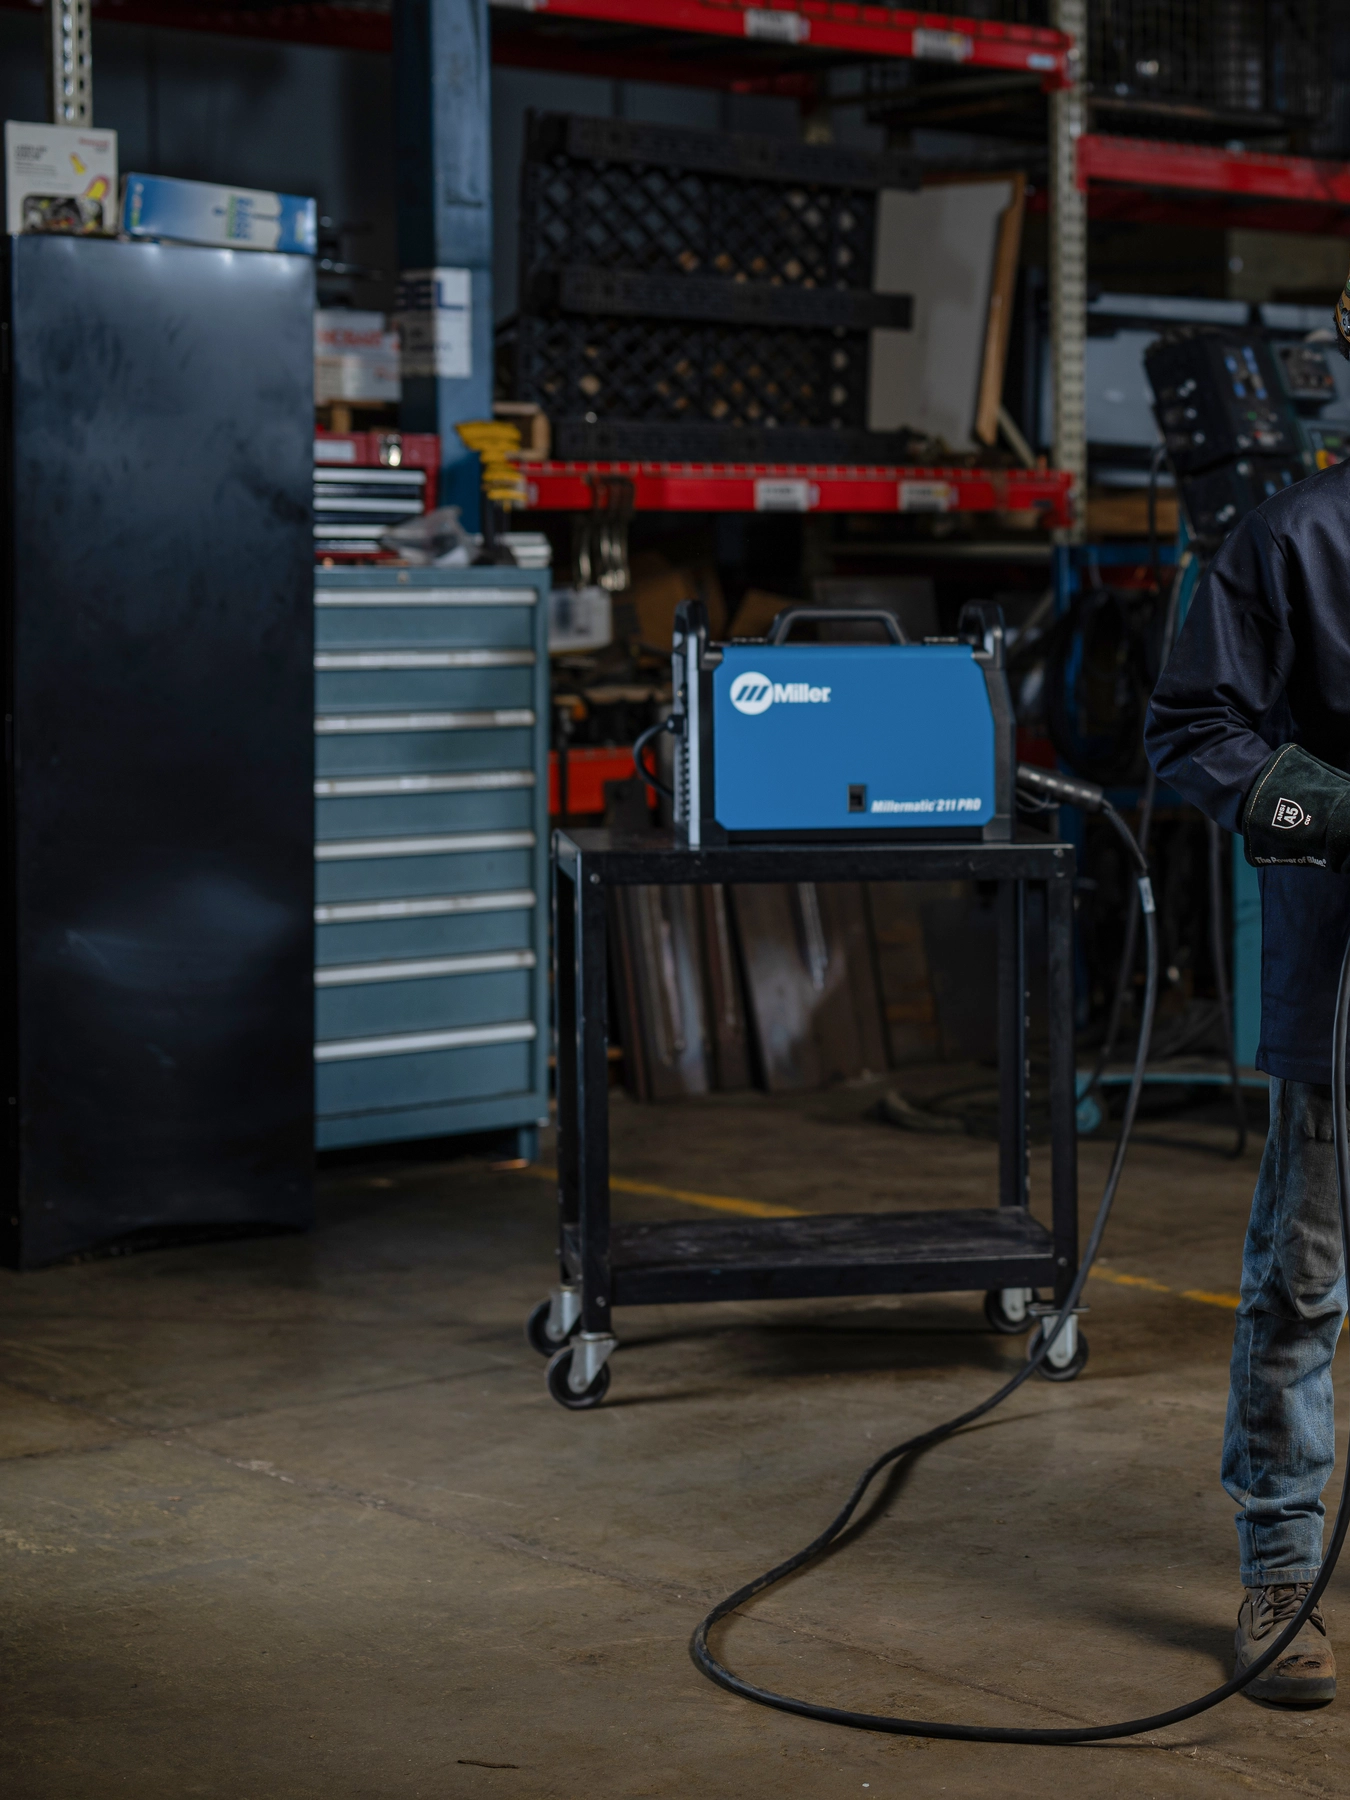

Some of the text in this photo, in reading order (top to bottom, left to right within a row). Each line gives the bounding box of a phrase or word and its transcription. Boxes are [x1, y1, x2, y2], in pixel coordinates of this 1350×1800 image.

[774, 683, 832, 703] Miller
[871, 797, 981, 813] Millermatic 211 PRO
[1276, 804, 1287, 822] ANSI
[1283, 806, 1299, 825] A5
[1304, 814, 1312, 826] CUT
[1255, 856, 1271, 864] The
[1270, 856, 1297, 864] Power
[1297, 856, 1306, 864] of
